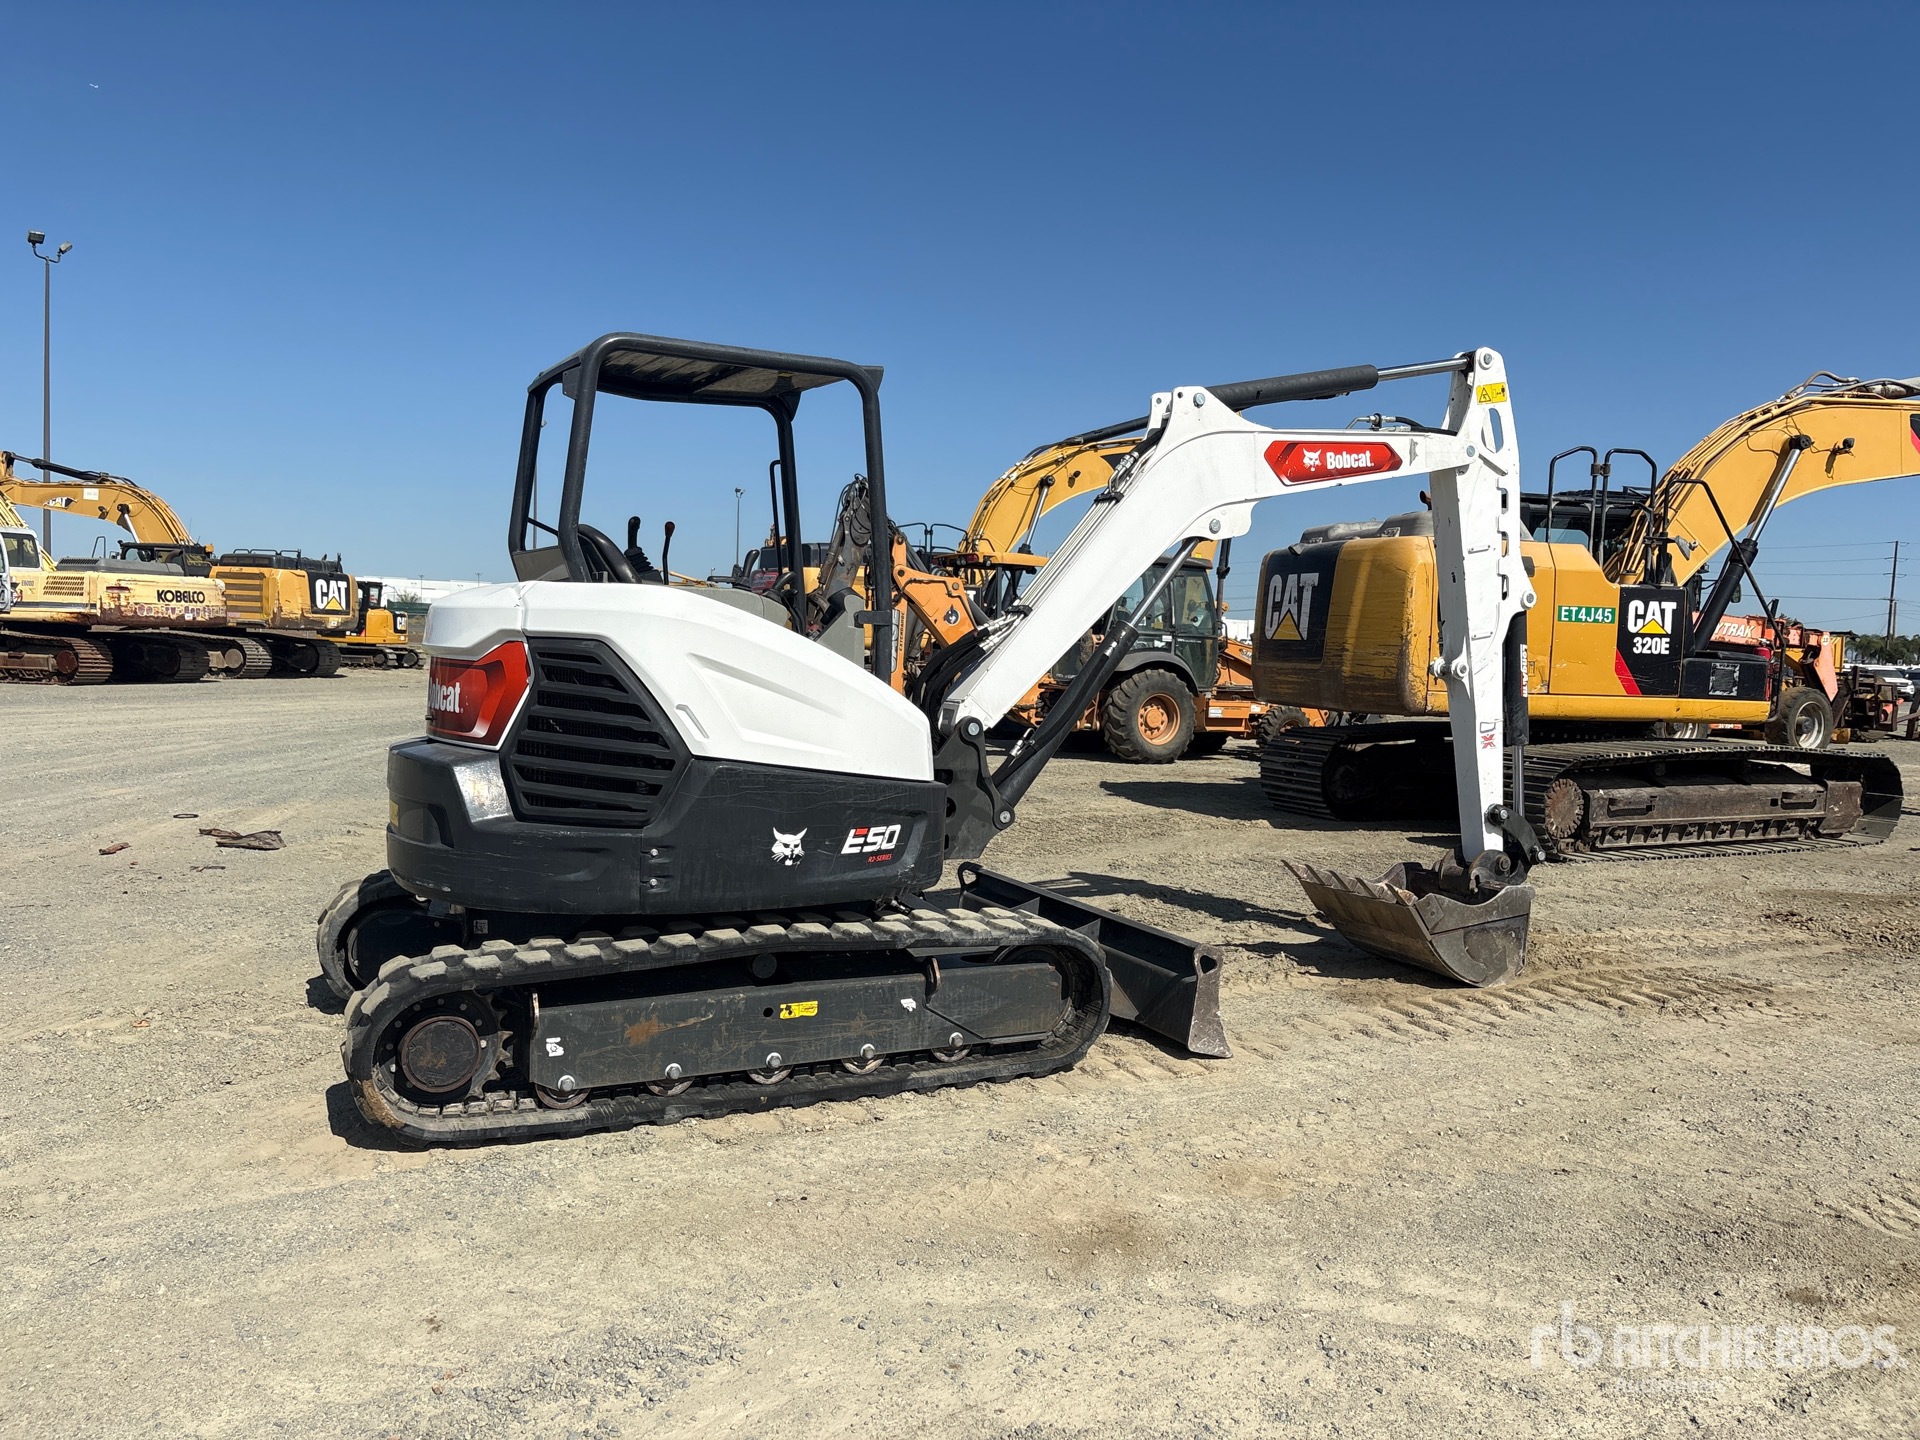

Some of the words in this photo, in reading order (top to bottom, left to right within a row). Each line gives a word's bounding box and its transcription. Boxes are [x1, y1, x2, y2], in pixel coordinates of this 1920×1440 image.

[1326, 450, 1372, 469] Bobcat
[156, 589, 206, 603] KOBELCO
[315, 578, 347, 610] CAT
[1265, 573, 1319, 640] CAT
[1561, 606, 1612, 623] ET4J45
[1627, 600, 1677, 634] CAT
[1632, 637, 1670, 655] 320E
[841, 824, 902, 854] E50
